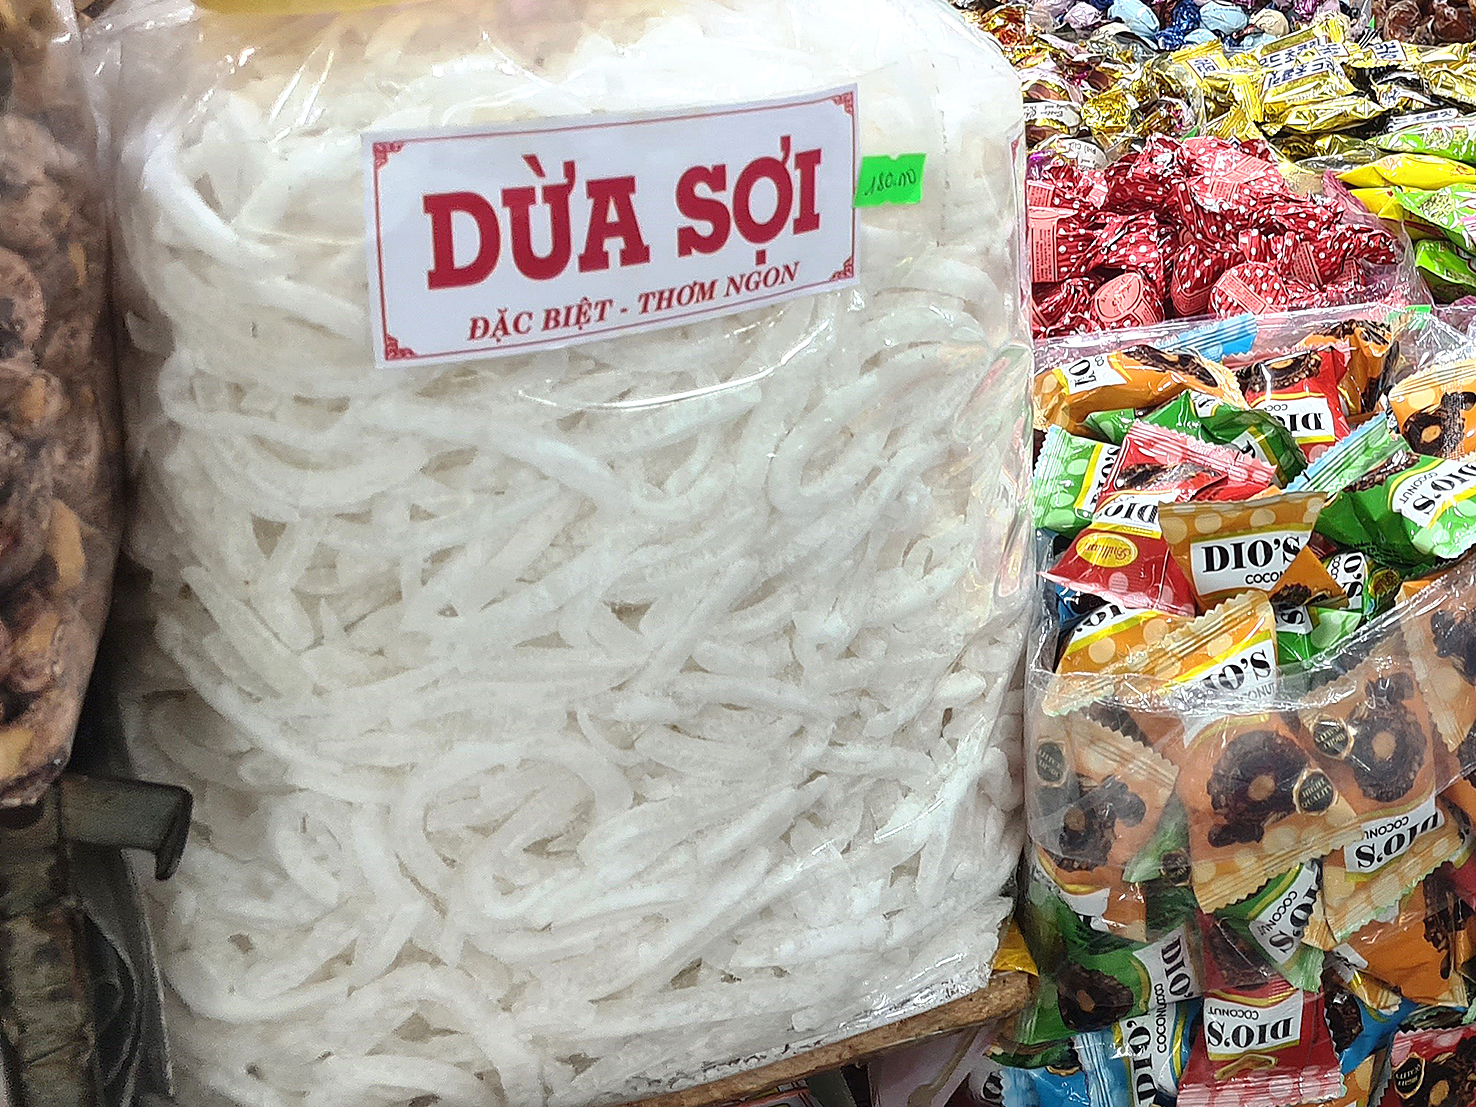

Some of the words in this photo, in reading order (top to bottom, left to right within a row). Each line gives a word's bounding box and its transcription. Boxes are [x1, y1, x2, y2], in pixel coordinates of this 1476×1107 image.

[423, 154, 650, 290] DỪA
[677, 136, 822, 266] SỢI
[468, 307, 533, 343] ĐẶC
[540, 297, 613, 334] BIỆT
[638, 278, 717, 316] THƠM
[724, 261, 801, 301] NGON
[1399, 471, 1440, 506] COCONUT
[1201, 536, 1301, 573] DIO'S
[1207, 1005, 1260, 1021] COCONUT
[1206, 1017, 1294, 1049] DIO'S
